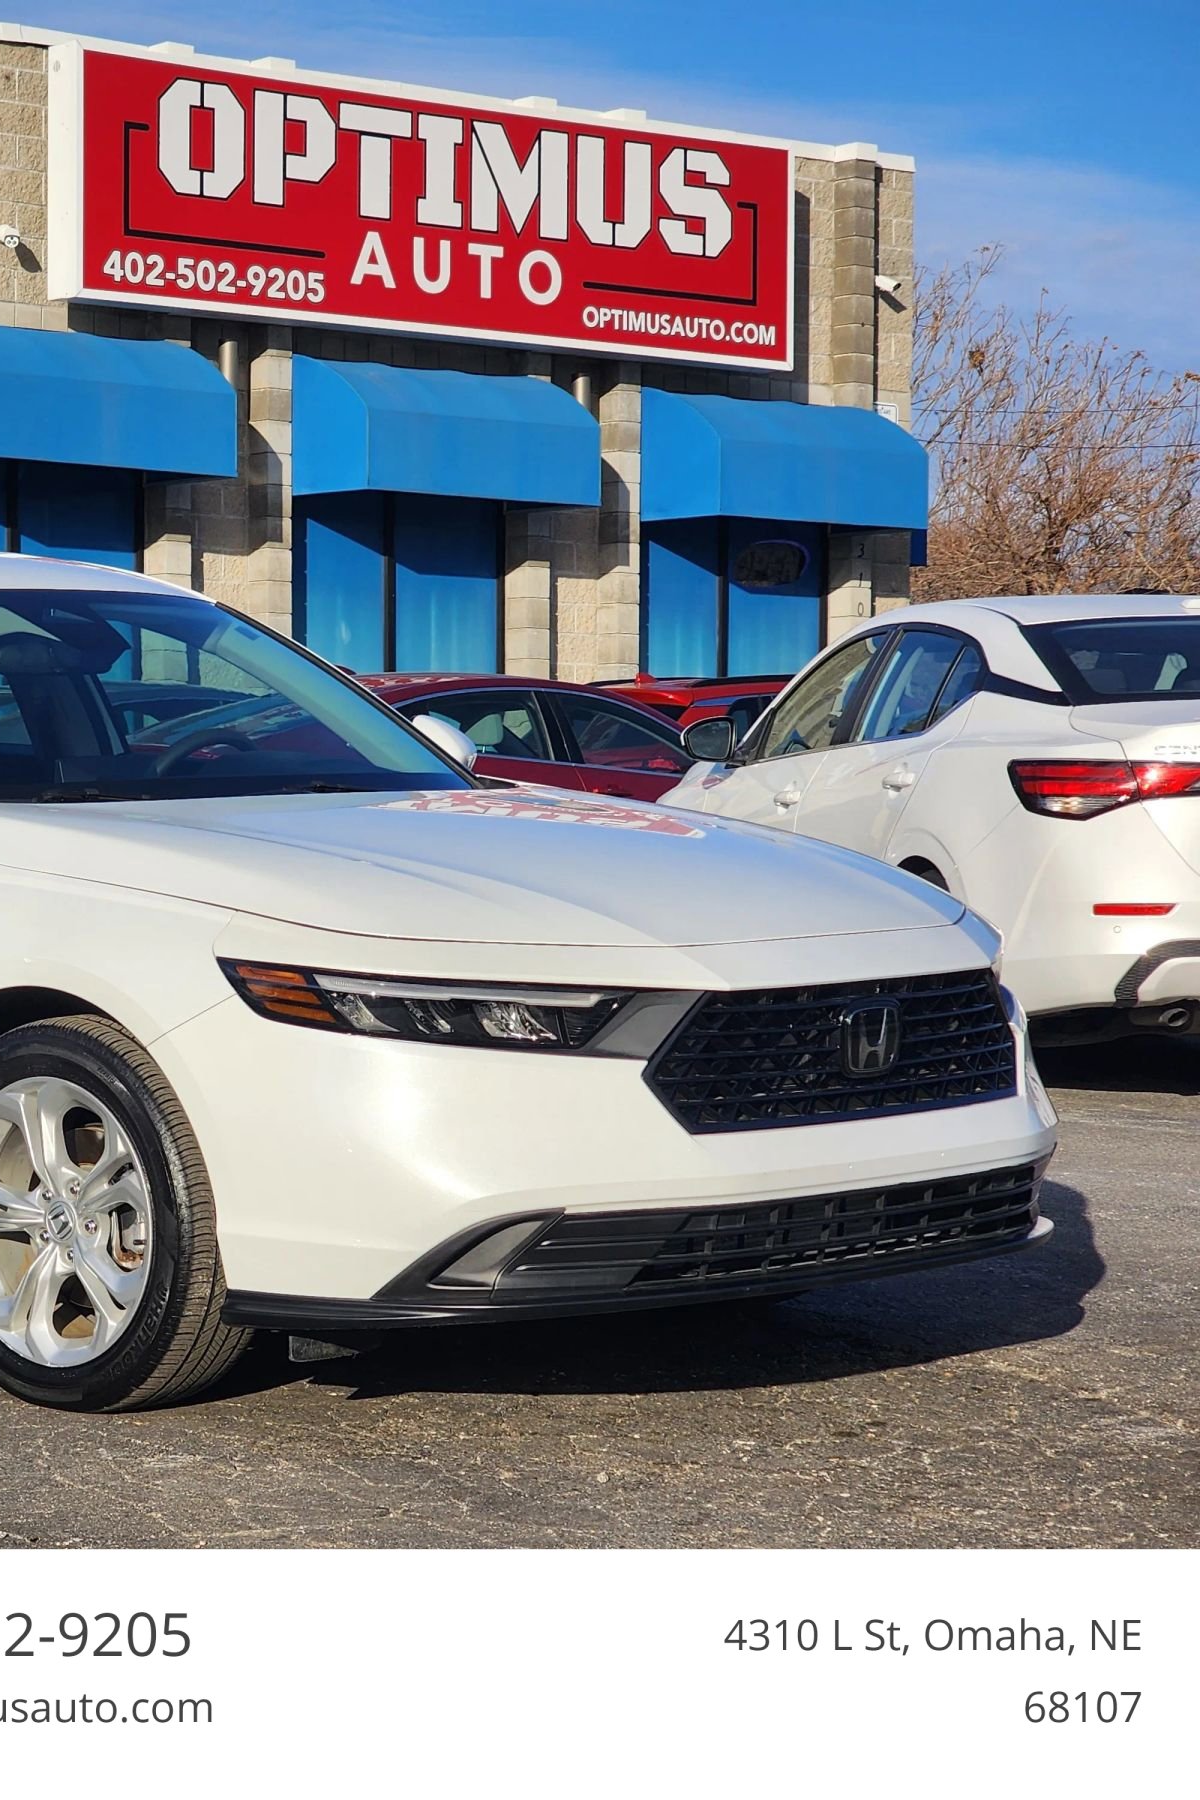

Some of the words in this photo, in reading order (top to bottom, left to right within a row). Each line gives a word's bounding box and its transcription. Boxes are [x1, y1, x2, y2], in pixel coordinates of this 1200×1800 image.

[159, 79, 732, 257] OPTIMUS
[103, 250, 325, 303] 402-502-9205
[350, 231, 562, 306] AUTO
[582, 306, 776, 346] OPTIMUSAUTO.COM
